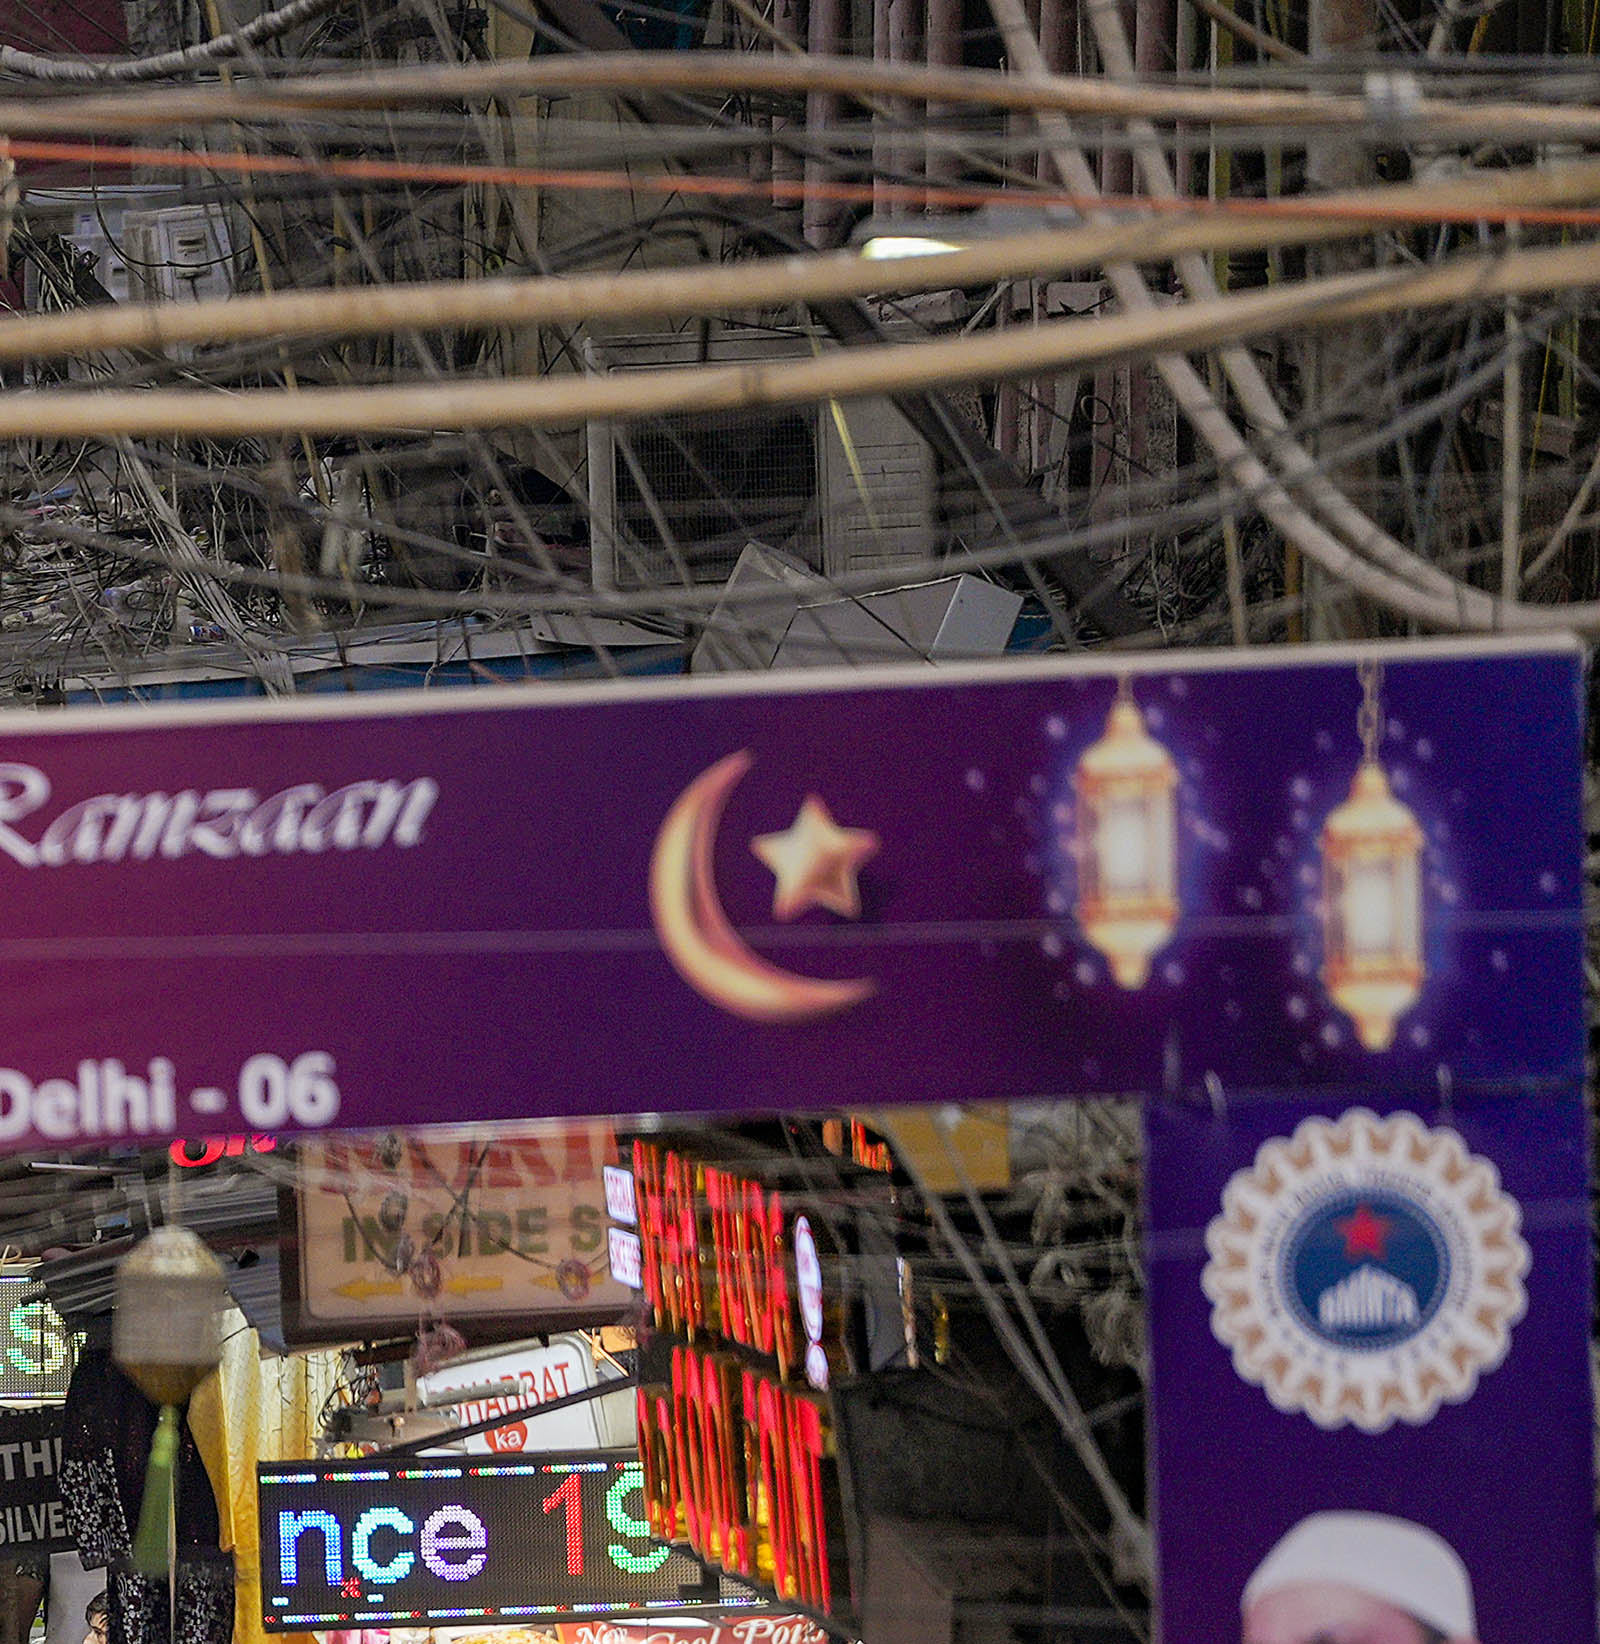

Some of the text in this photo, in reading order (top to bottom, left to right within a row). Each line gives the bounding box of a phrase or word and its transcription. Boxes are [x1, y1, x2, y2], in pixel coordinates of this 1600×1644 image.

[189, 1083, 229, 1116] -
[238, 1049, 342, 1131] 06
[495, 1428, 523, 1448] ka
